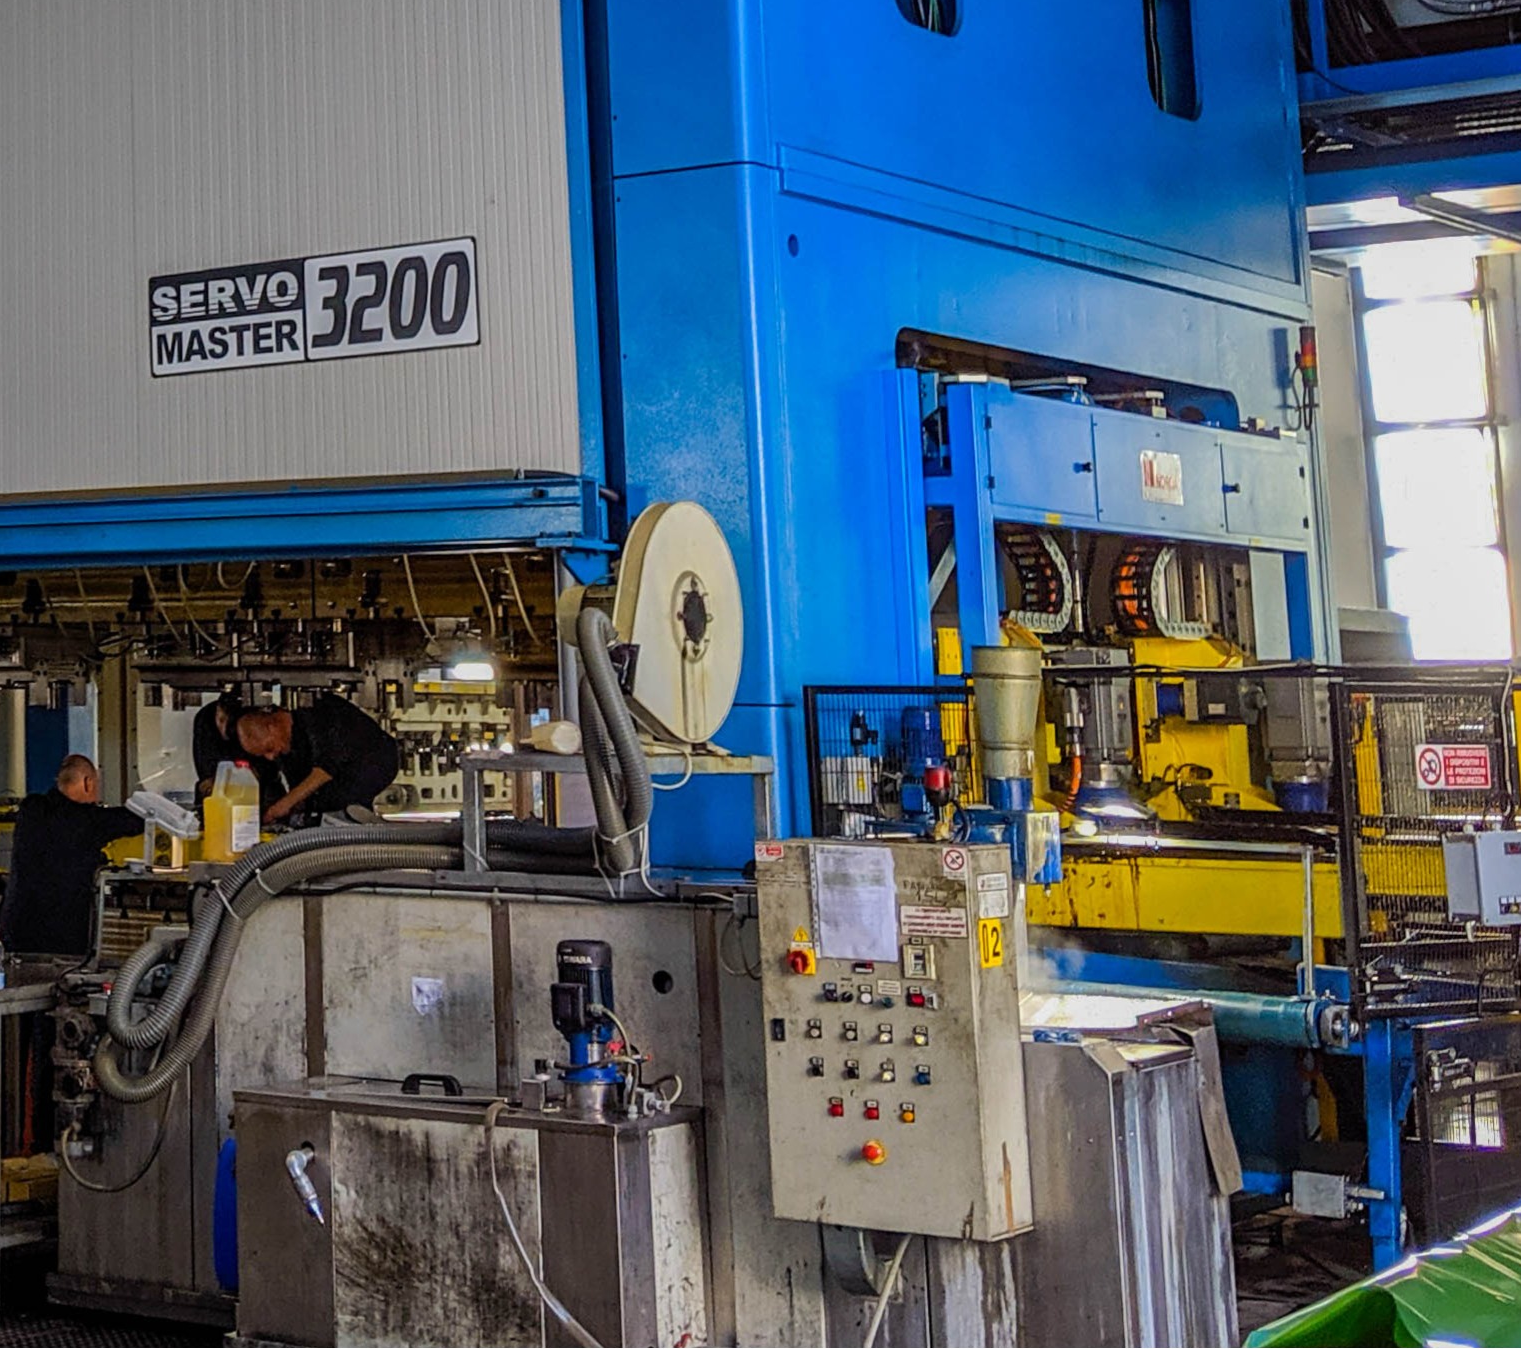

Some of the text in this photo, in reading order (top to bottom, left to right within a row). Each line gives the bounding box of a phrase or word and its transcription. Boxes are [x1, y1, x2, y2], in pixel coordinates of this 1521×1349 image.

[152, 271, 299, 321] SERVO
[311, 252, 470, 348] 3200
[157, 319, 300, 365] MASTER
[982, 923, 1000, 963] 02
